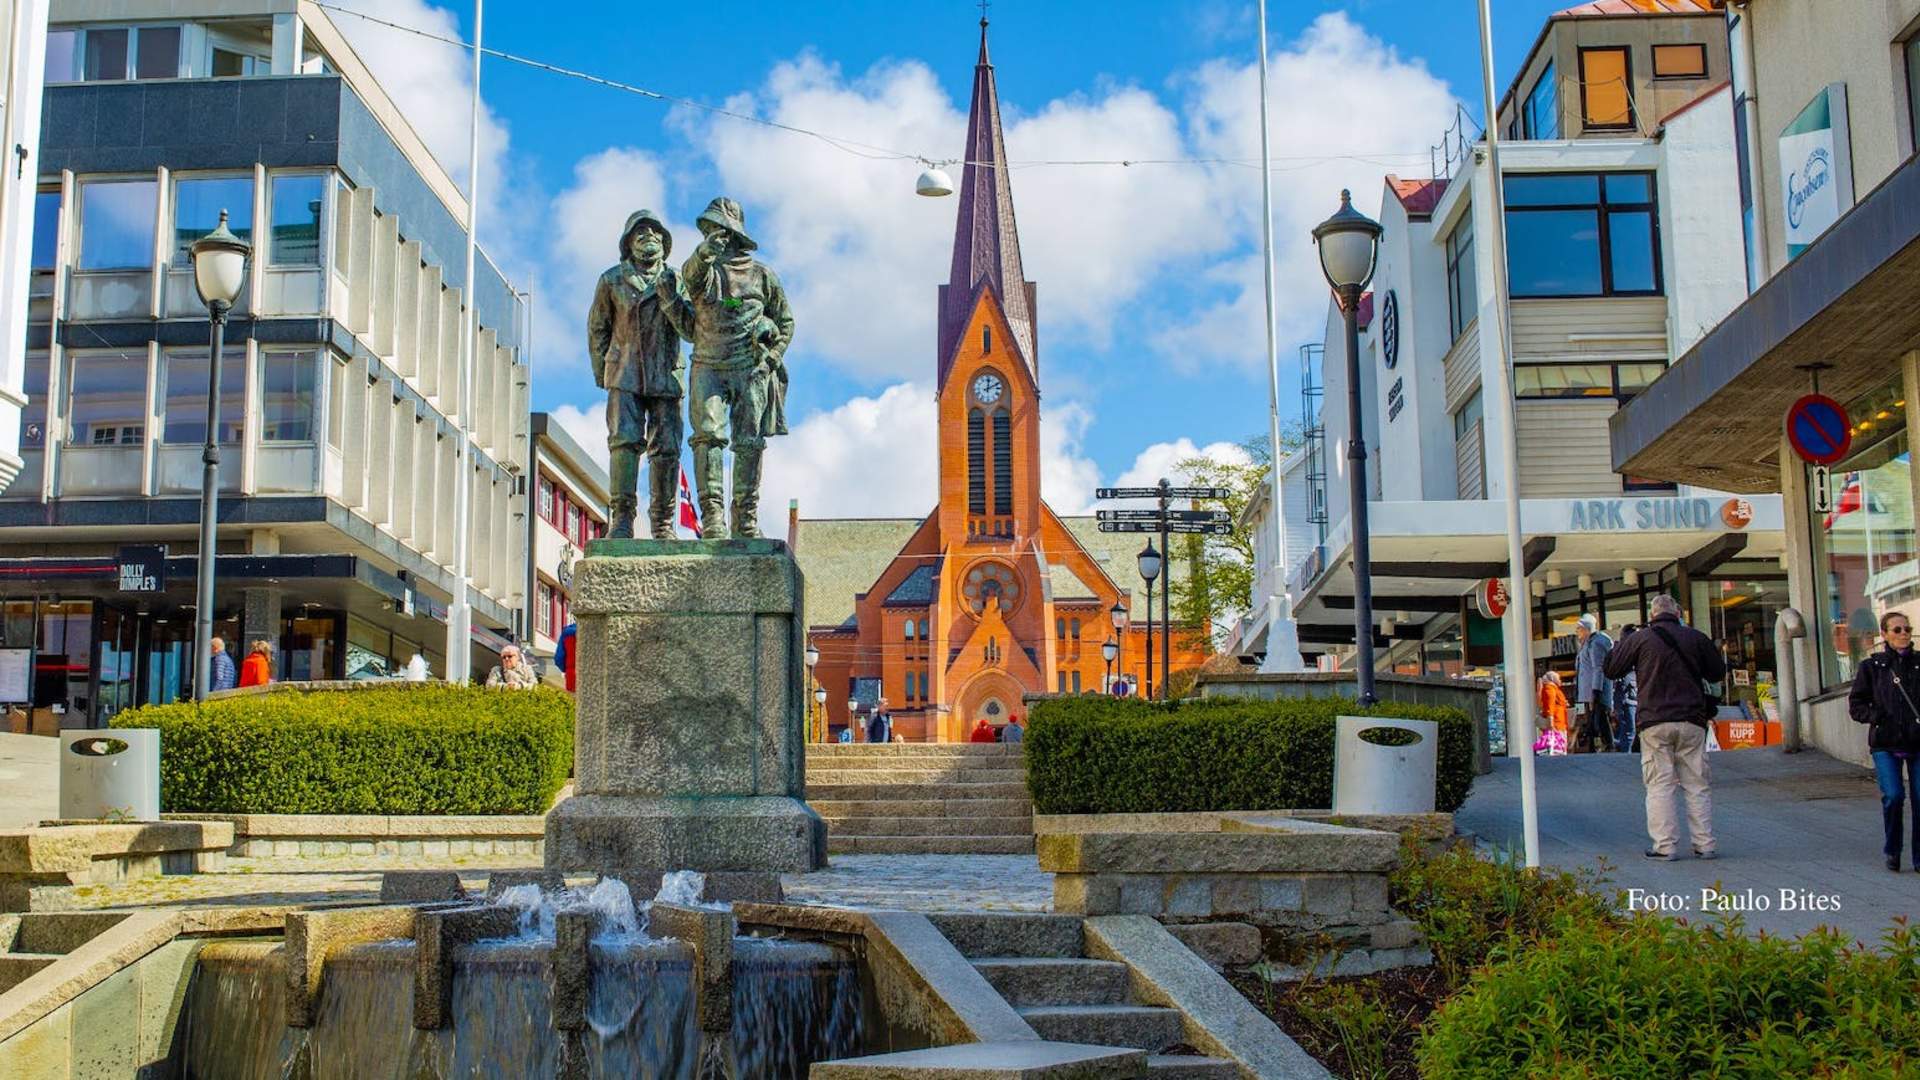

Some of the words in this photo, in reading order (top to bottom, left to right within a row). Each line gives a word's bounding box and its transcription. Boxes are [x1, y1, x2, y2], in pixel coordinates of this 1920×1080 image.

[1571, 501, 1625, 530] ARK
[1635, 499, 1712, 529] SUND
[120, 564, 145, 577] DOLLY
[119, 575, 156, 591] DIMPLE'S
[1551, 636, 1577, 656] ARK
[1730, 729, 1755, 739] KUPP
